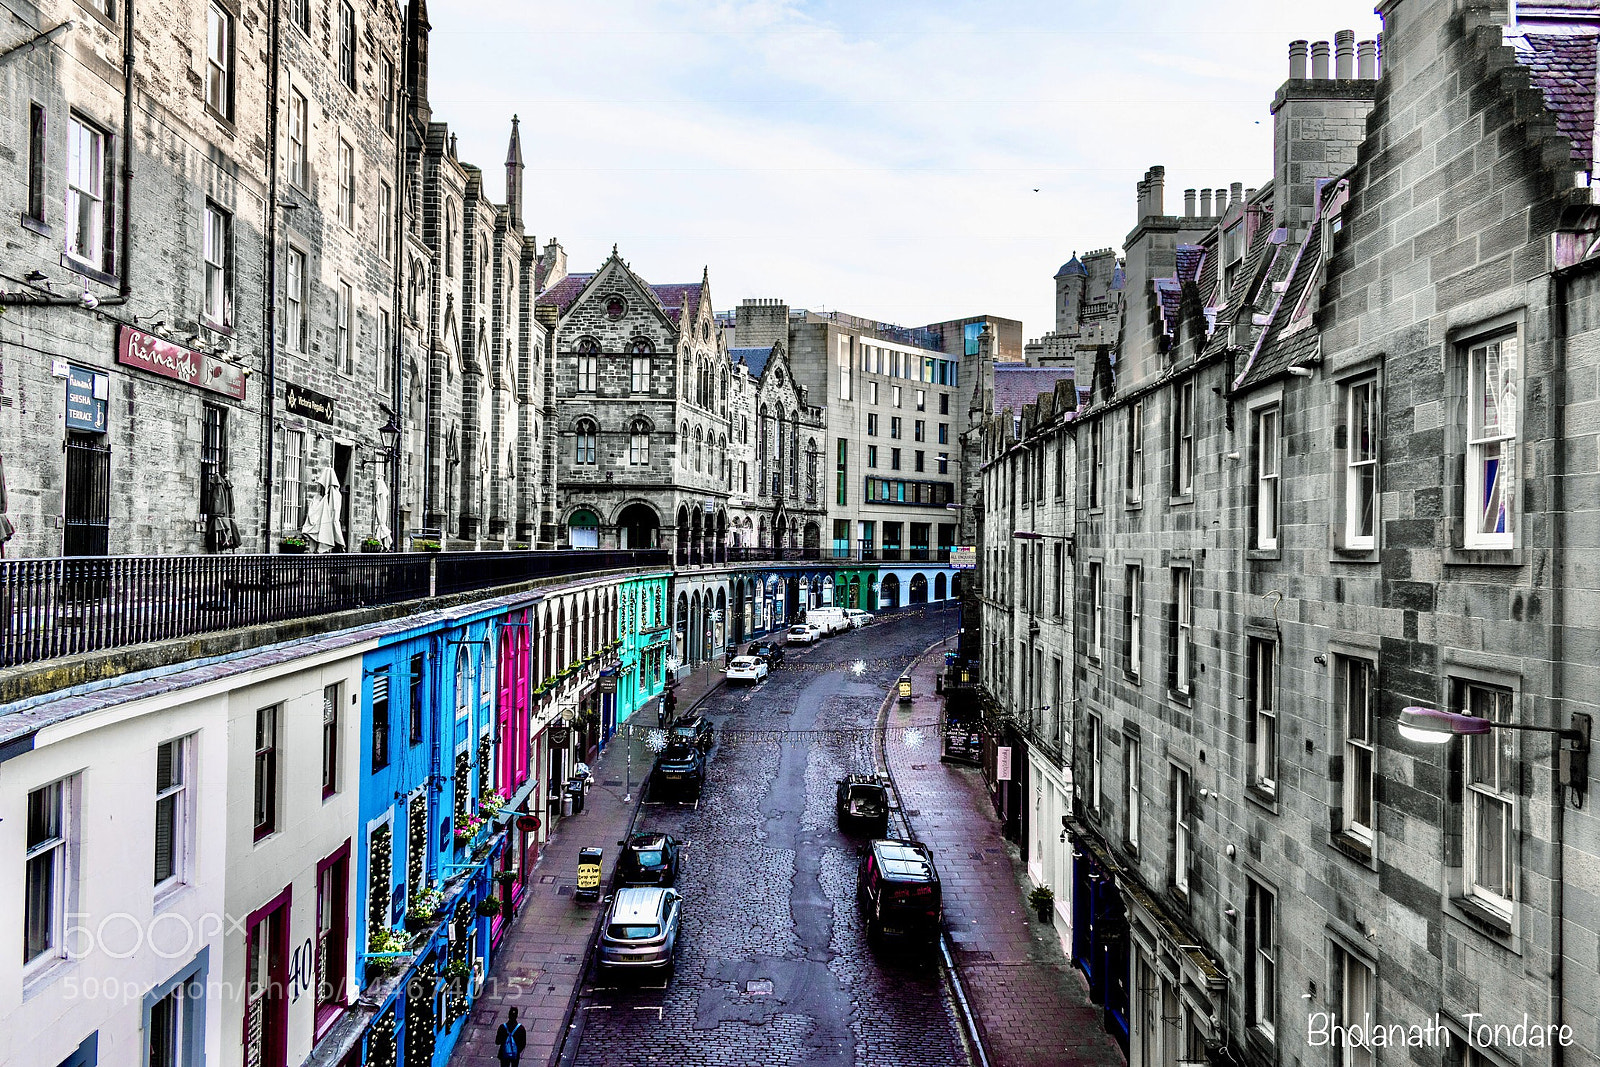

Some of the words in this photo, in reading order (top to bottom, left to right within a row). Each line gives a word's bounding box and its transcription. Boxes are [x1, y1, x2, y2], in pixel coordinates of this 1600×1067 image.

[70, 393, 91, 405] SHISHA
[69, 409, 93, 421] TERRACE
[288, 937, 313, 1005] 40
